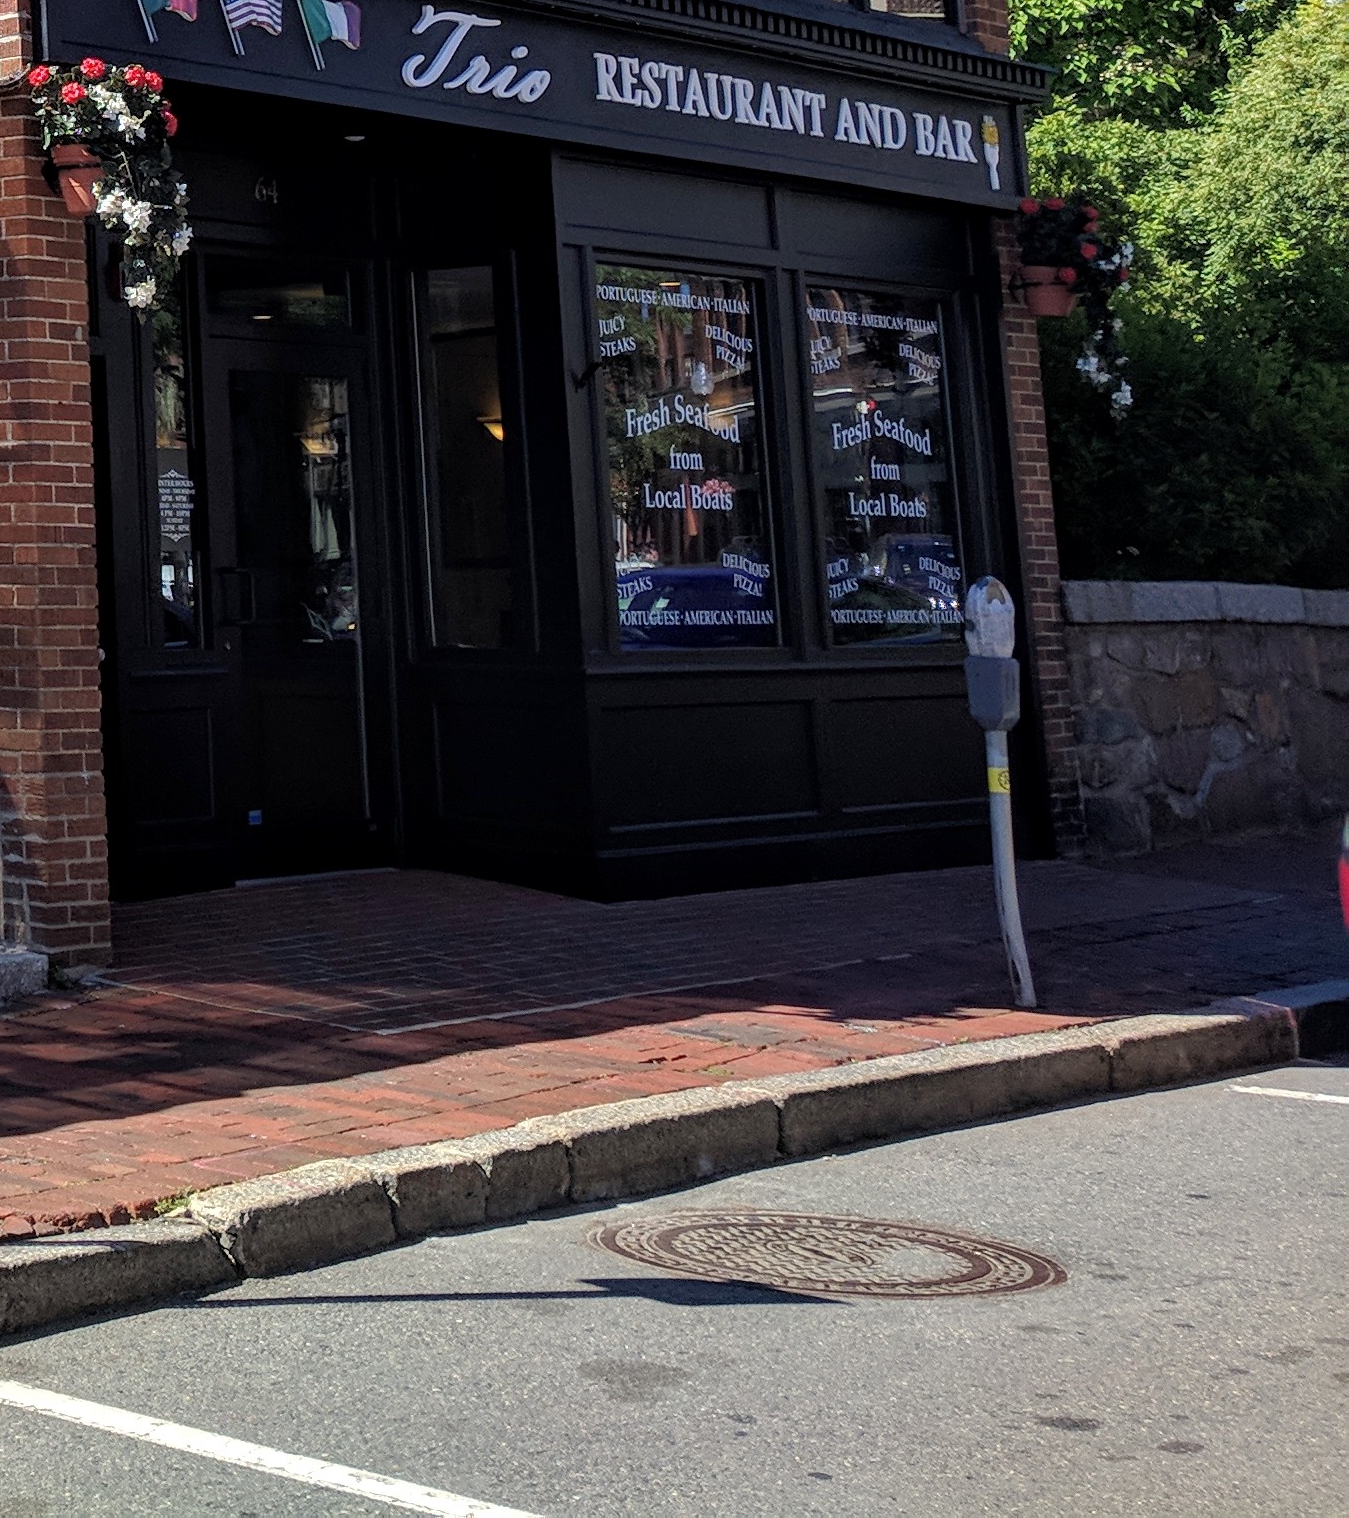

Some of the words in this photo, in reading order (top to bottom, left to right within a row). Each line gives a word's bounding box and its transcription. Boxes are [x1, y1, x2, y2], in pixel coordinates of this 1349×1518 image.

[402, 4, 551, 103] Trio
[593, 52, 826, 137] RESTAURANT
[834, 97, 907, 149] AND
[913, 112, 979, 164] BAR
[255, 177, 279, 204] 64
[600, 336, 637, 358] STEAKS
[705, 325, 753, 353] DELICIOUS
[899, 343, 941, 369] DELICIOUS
[625, 398, 671, 438] Fresh
[832, 412, 872, 450] Fresh
[873, 410, 933, 456] Seafood
[670, 444, 704, 471] from
[870, 455, 901, 481] from
[643, 483, 687, 509] Local
[690, 484, 734, 511] Boats
[848, 492, 887, 517] Local
[889, 493, 927, 518] Boats
[722, 553, 770, 579] DELICIOUS
[919, 557, 961, 581] DELICIOUS
[733, 573, 763, 597] PIZZA!
